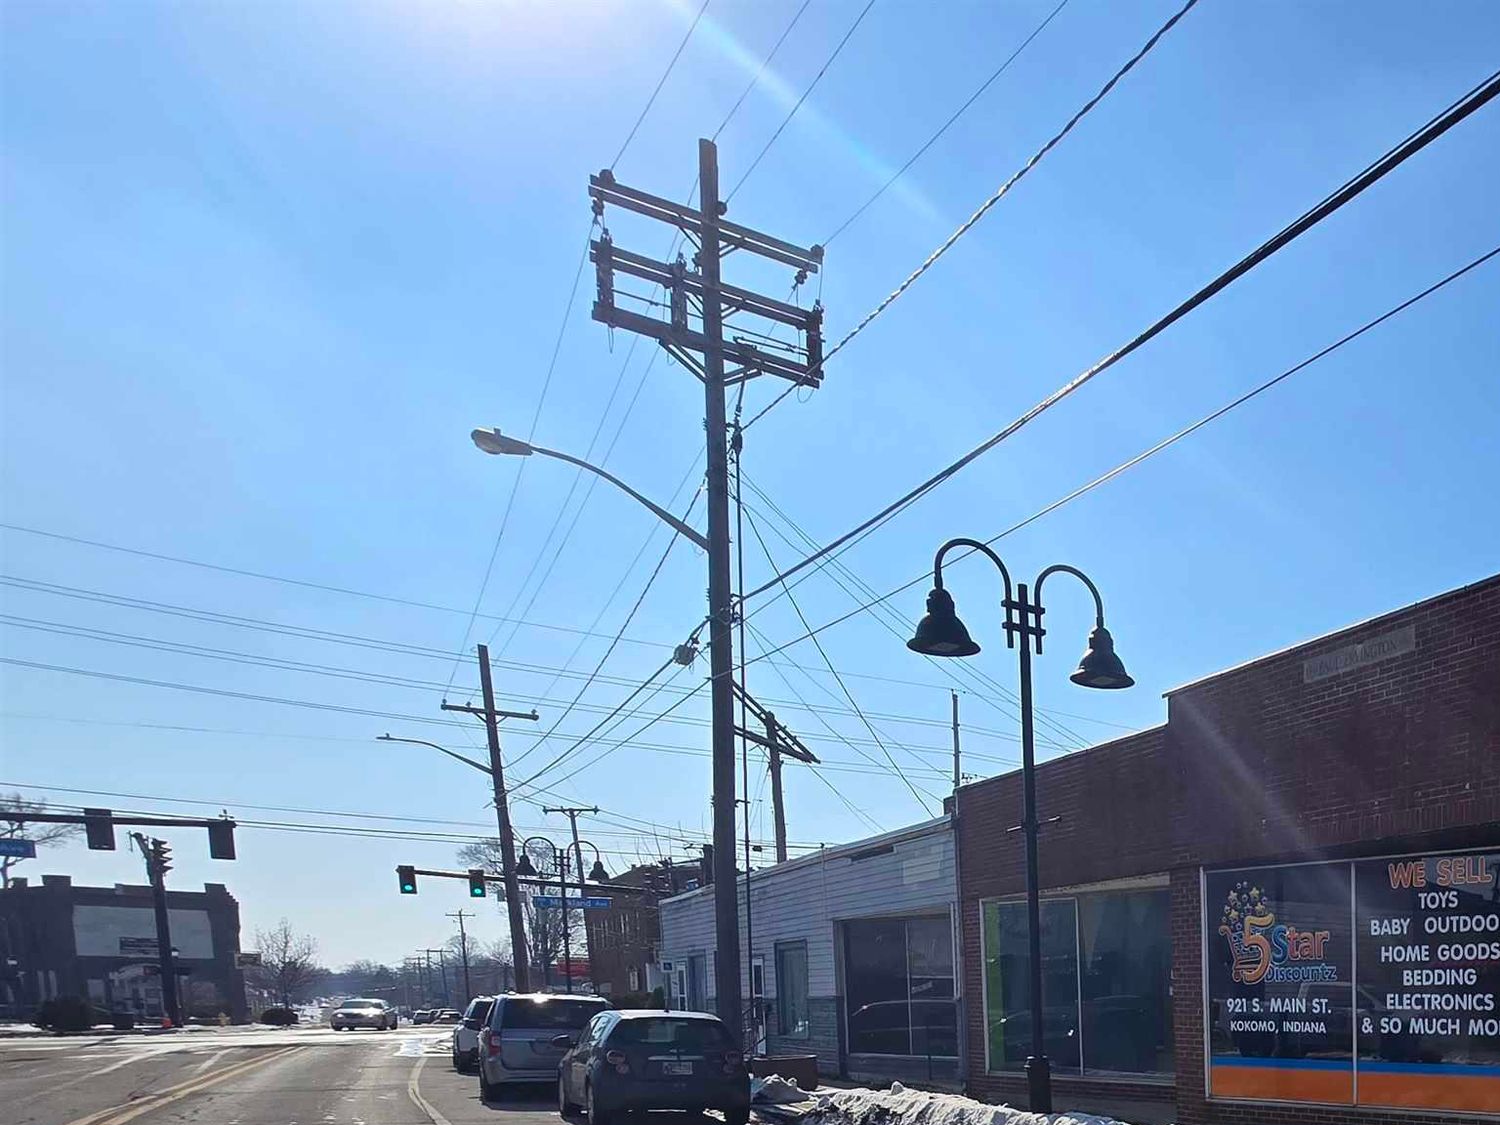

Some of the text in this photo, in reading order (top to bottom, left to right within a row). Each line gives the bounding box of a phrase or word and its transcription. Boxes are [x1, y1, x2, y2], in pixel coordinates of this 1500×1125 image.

[1388, 856, 1493, 889] WE SELL
[548, 899, 592, 908] Makland
[1418, 891, 1459, 909] TOYS
[1370, 918, 1411, 936] BABY
[1243, 912, 1330, 985] 5 Star
[1380, 943, 1500, 962] HOME GOODS
[1264, 963, 1337, 982] Discountz
[1403, 969, 1477, 986] BEDDING
[1227, 998, 1332, 1014] 921 S. MAIN ST.
[1386, 994, 1495, 1011] ELECTRONICS
[1230, 1020, 1327, 1034] KOKOMO, INDIANA
[1361, 1017, 1373, 1033] &
[1380, 1017, 1402, 1034] SO
[1409, 1018, 1460, 1035] MUCH
